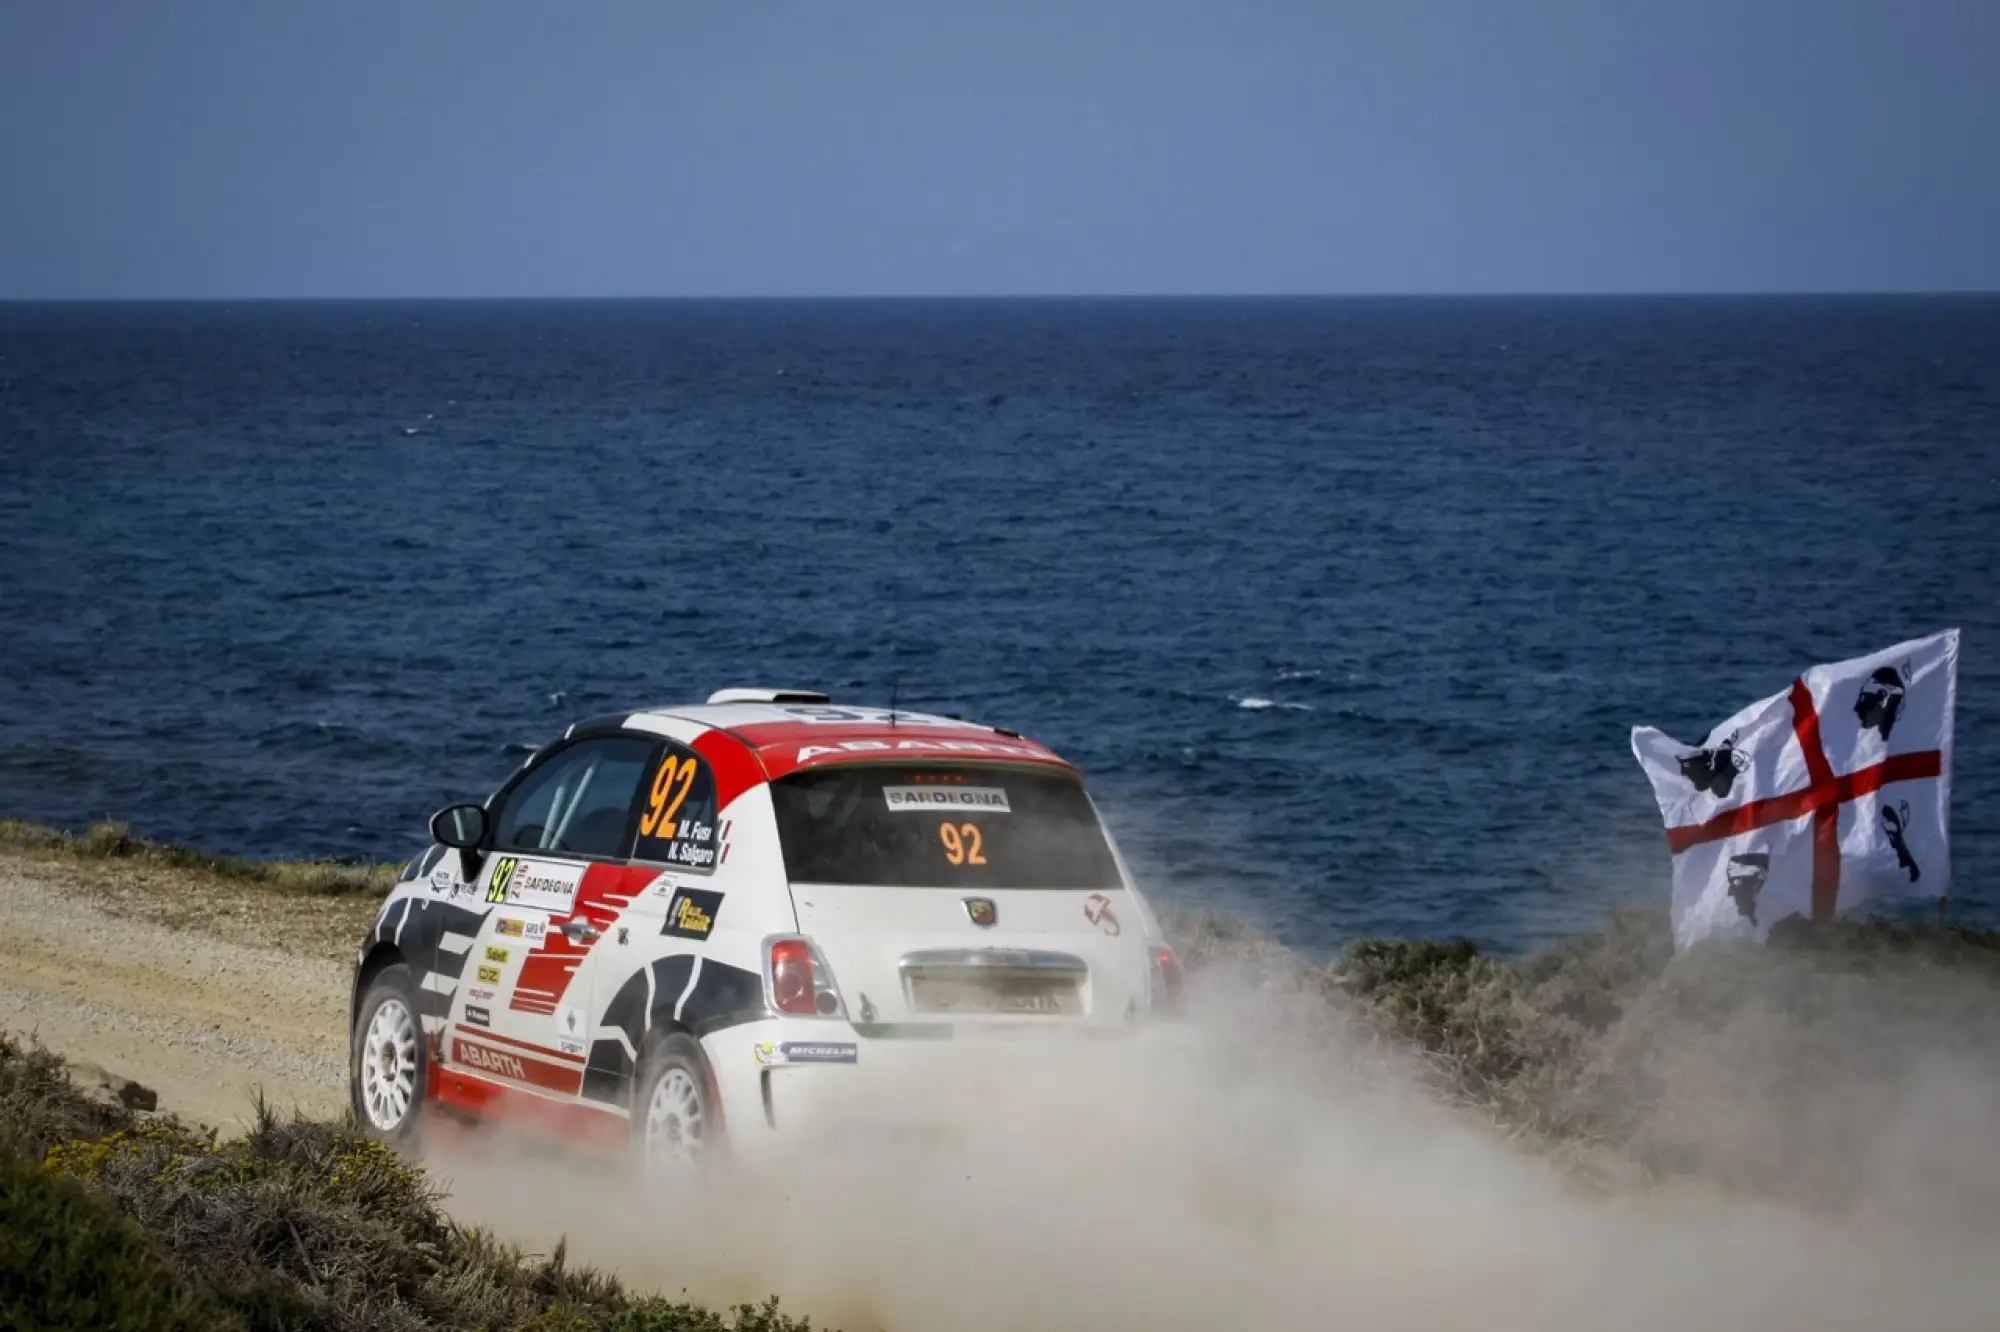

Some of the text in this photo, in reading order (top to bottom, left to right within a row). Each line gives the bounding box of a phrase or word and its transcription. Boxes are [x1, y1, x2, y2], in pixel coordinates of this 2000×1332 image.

[641, 754, 697, 838] 92
[889, 791, 1005, 807] SARDEGNA
[939, 822, 987, 866] 92
[487, 857, 518, 903] 92
[524, 876, 574, 895] SARDEGNA
[459, 1041, 526, 1079] ABARTH
